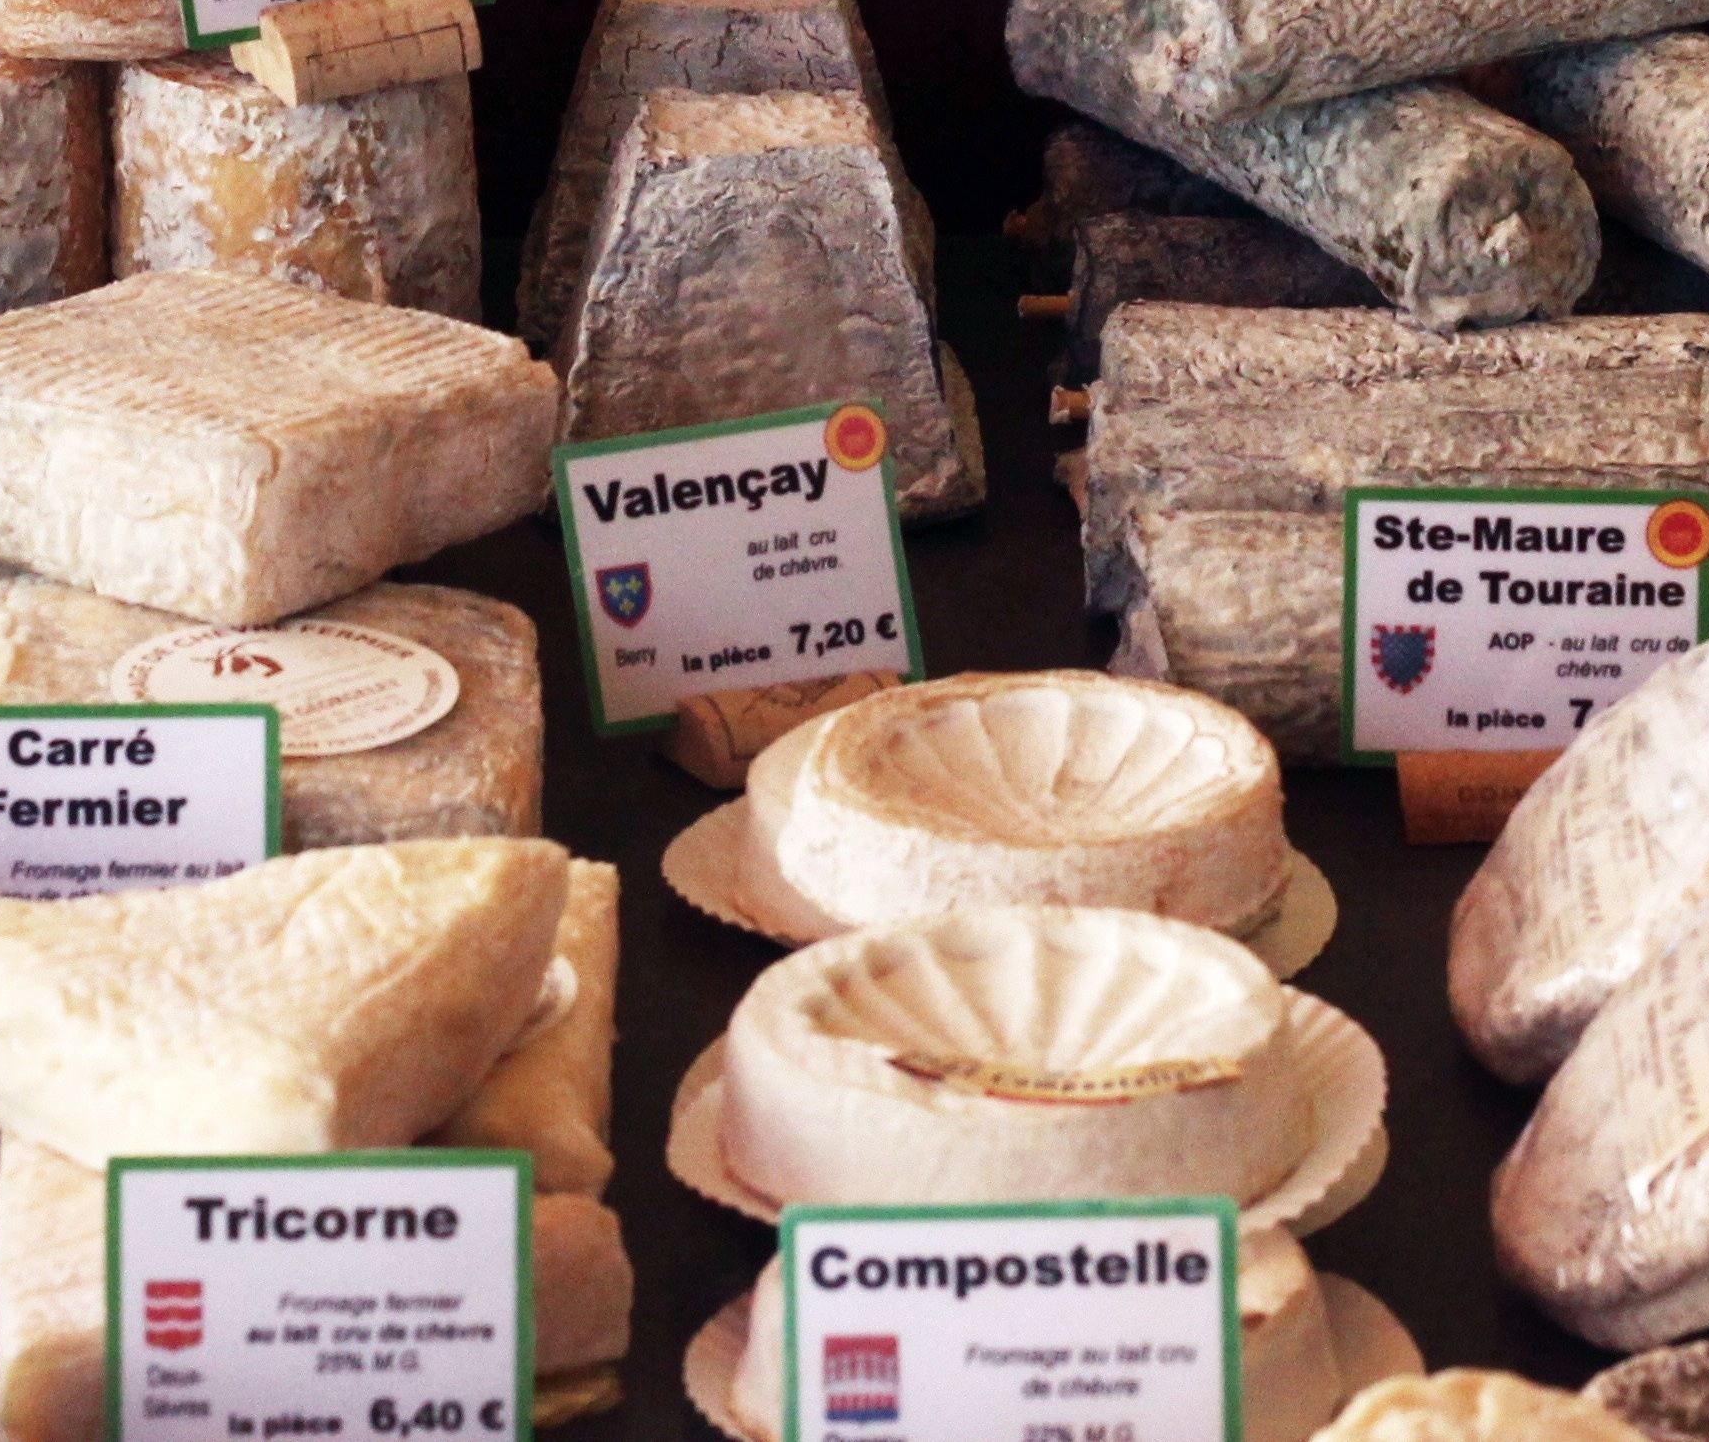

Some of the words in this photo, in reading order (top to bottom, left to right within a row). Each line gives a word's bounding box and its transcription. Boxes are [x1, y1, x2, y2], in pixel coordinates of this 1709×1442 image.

[583, 458, 829, 524] Valençay
[747, 538, 770, 557] au
[773, 533, 799, 553] lait
[809, 528, 837, 546] cru
[1373, 514, 1626, 553] Ste-Maure
[752, 562, 775, 582] de
[1407, 569, 1464, 605] de
[1479, 570, 1686, 608] Touraine
[788, 618, 866, 657] 7,20
[875, 612, 898, 641] €
[1488, 632, 1535, 652] AOP
[1561, 636, 1585, 653] au
[1590, 632, 1619, 653] lait
[1630, 636, 1661, 653] cru
[1665, 633, 1691, 653] de
[681, 653, 704, 673] la
[709, 644, 772, 674] pièce
[1556, 657, 1622, 680] chèvre
[1446, 708, 1471, 728] la
[1477, 708, 1547, 732] pièce
[7, 728, 156, 767] Carré
[10, 859, 102, 884] Fromage
[107, 860, 178, 880] fermier
[184, 1194, 460, 1243] Tricorne
[810, 1239, 1209, 1301] Compostelle
[368, 1396, 466, 1439] 6,40
